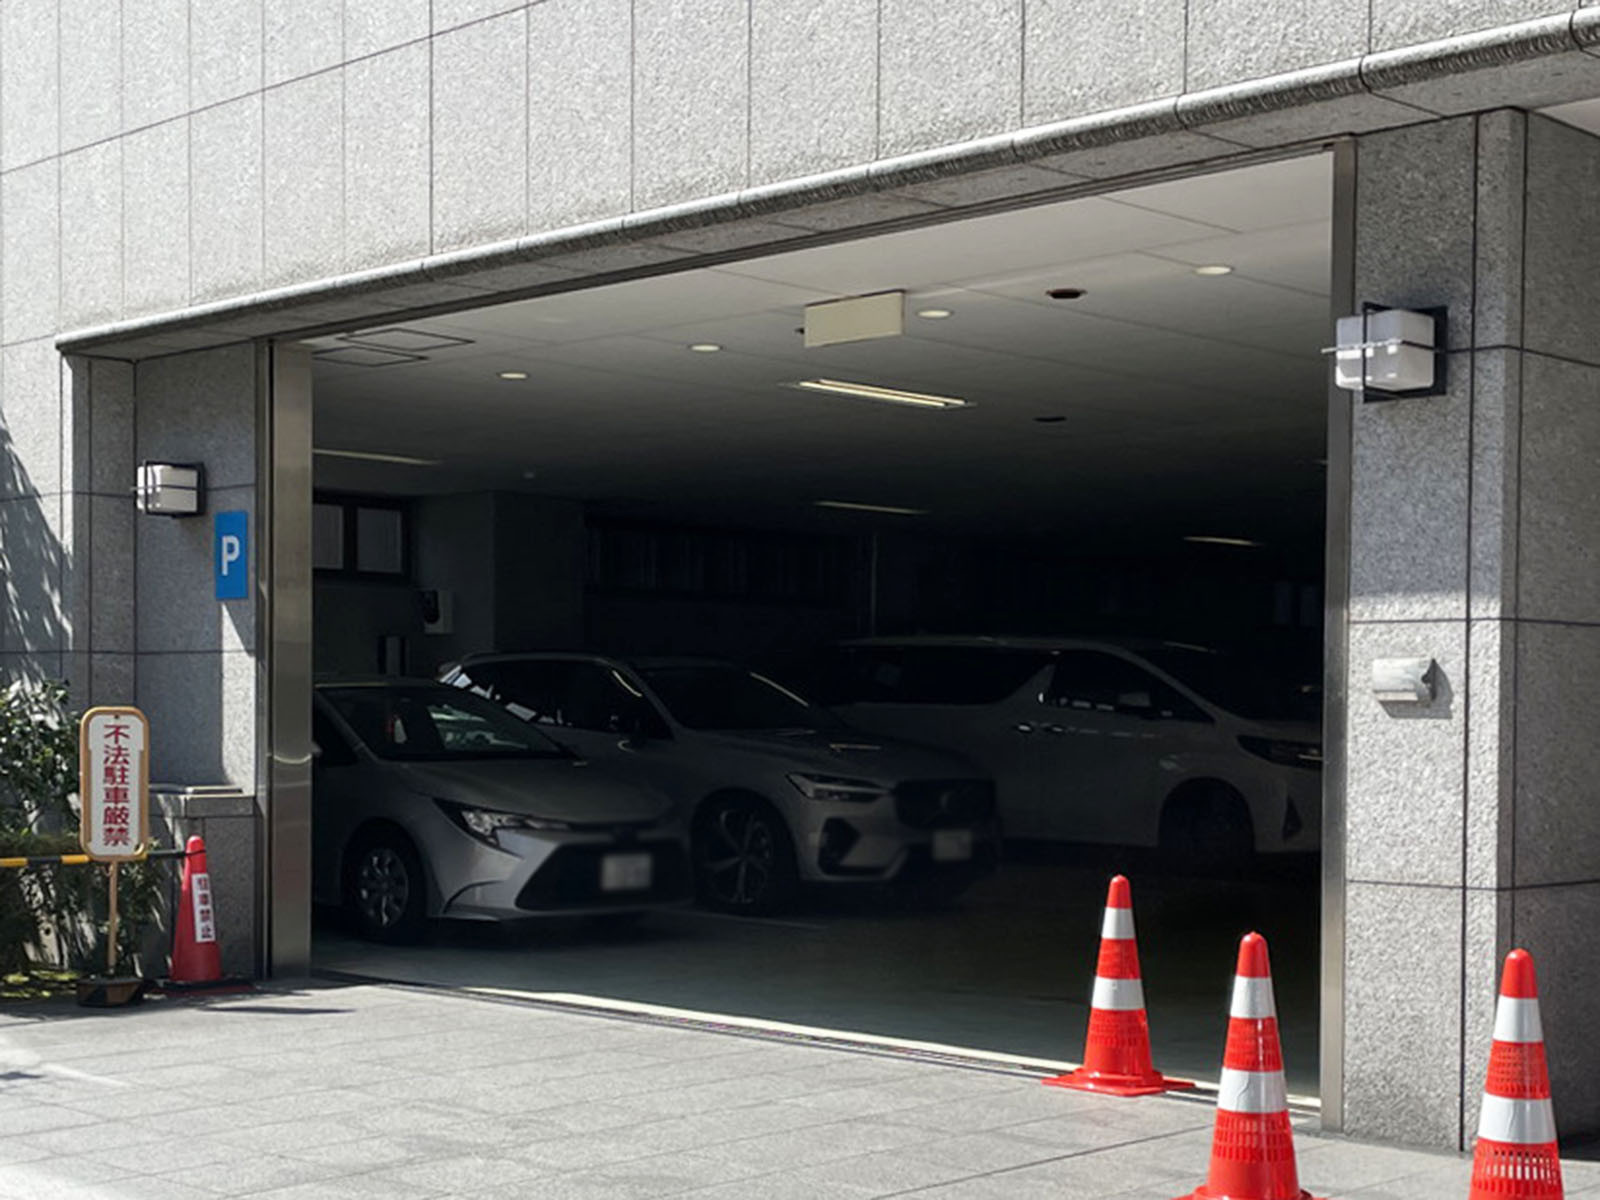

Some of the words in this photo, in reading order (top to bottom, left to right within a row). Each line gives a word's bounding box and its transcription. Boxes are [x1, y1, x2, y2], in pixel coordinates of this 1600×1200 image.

[222, 535, 240, 576] P
[103, 724, 131, 847] 不法駐車厳禁
